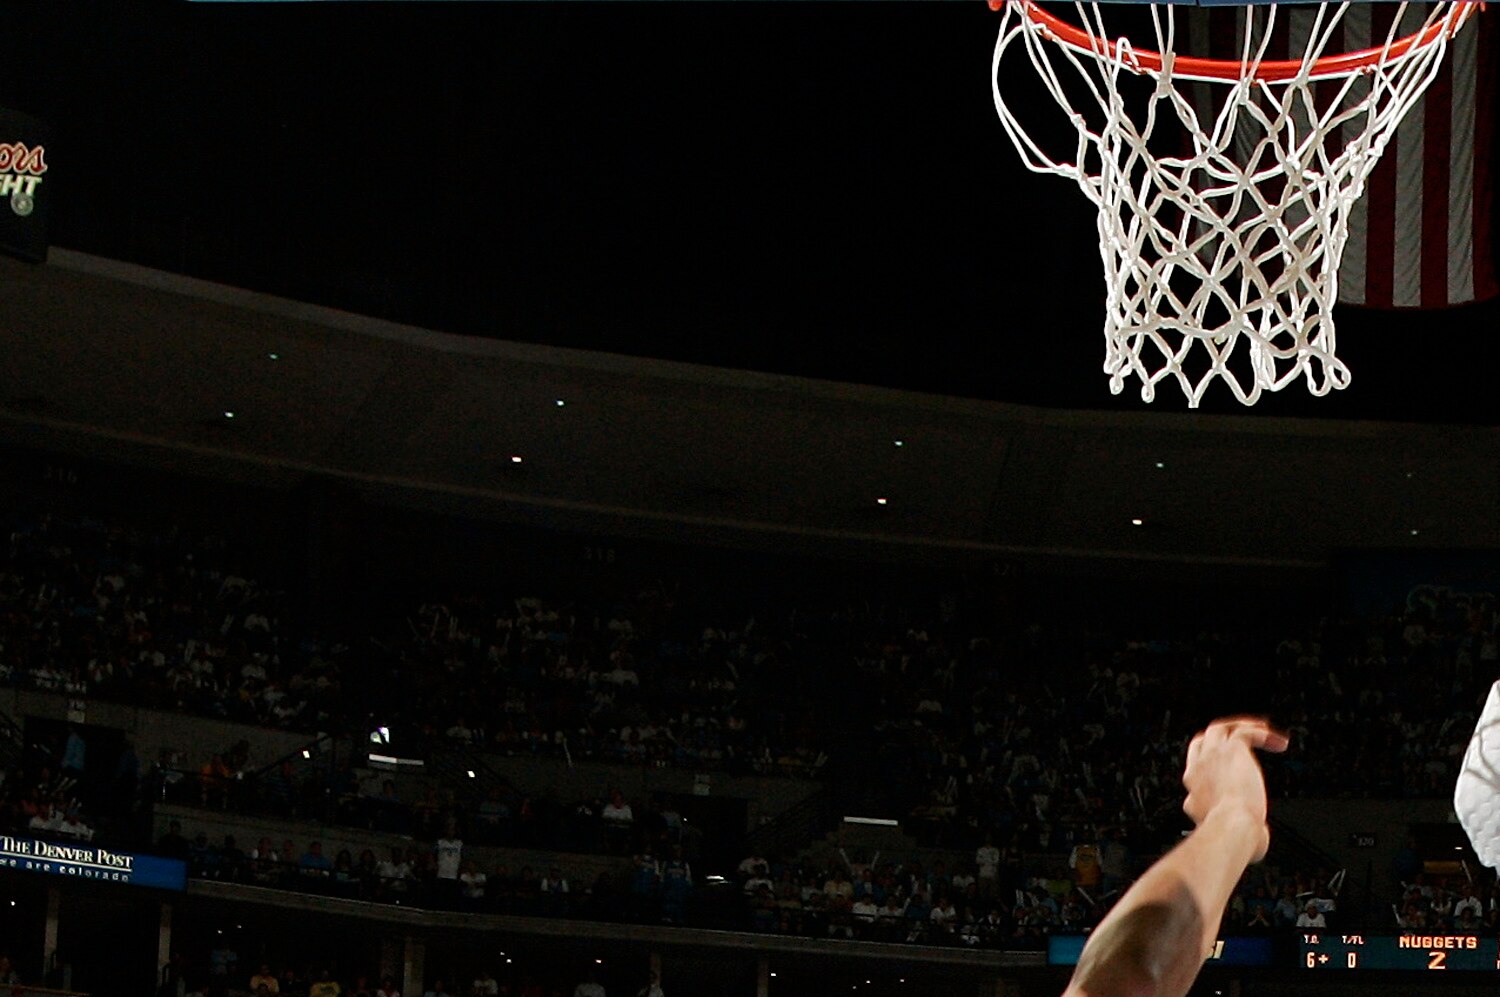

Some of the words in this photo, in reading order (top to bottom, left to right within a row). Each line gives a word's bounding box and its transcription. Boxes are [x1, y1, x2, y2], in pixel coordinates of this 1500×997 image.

[0, 836, 30, 851] THE
[34, 840, 93, 862] DENVER
[97, 849, 133, 868] POST
[26, 860, 50, 871] are
[59, 865, 129, 882] colorado
[1400, 936, 1478, 949] NUGGETS
[1347, 952, 1356, 968] 0
[1428, 951, 1446, 969] 2
